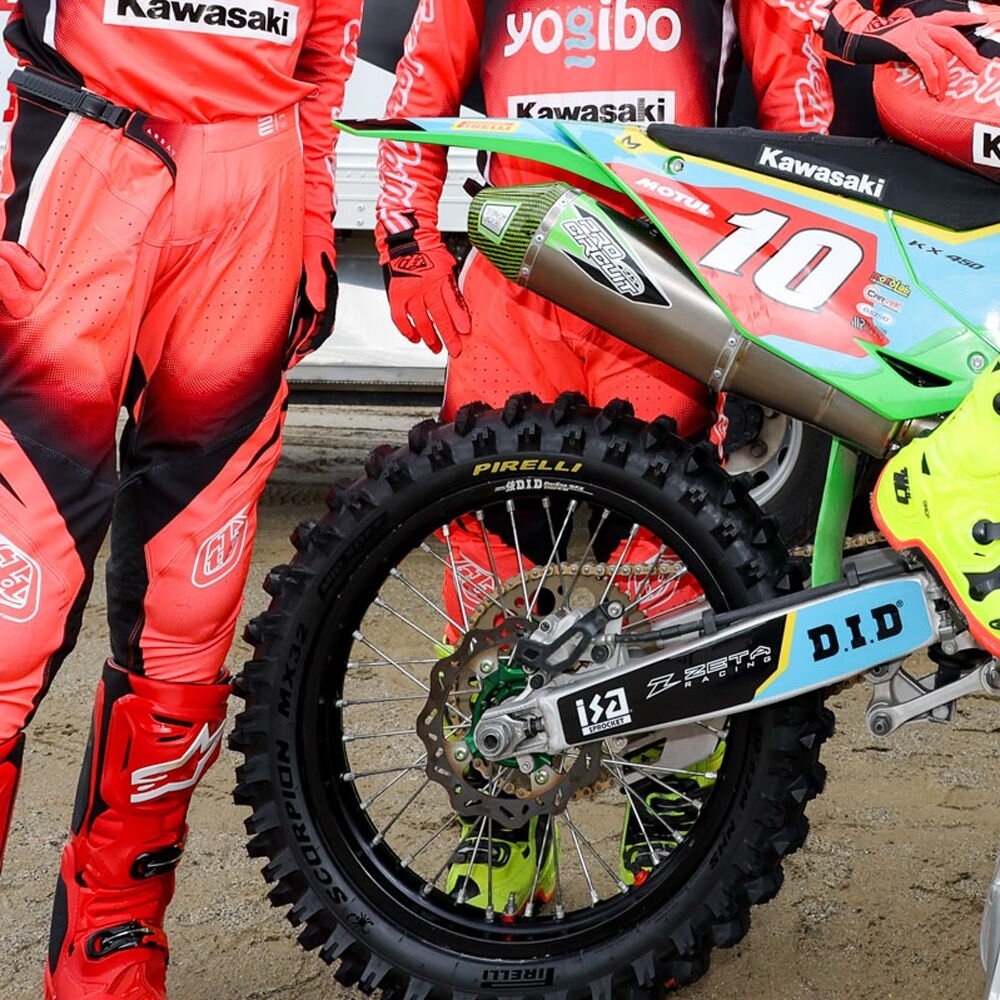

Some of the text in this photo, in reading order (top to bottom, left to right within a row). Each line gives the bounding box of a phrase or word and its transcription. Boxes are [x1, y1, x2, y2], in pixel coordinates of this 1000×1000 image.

[516, 98, 666, 122] Kawasaki
[759, 146, 886, 199] Kawasaki
[635, 177, 715, 218] MOTUL
[699, 208, 865, 313] 10
[472, 459, 583, 476] PIRELLI
[684, 645, 772, 681] ZETA
[684, 655, 772, 688] RACING
[588, 716, 625, 734] SPROCKET
[276, 739, 348, 905] SCORPION
[480, 967, 556, 990] PIRELLI
